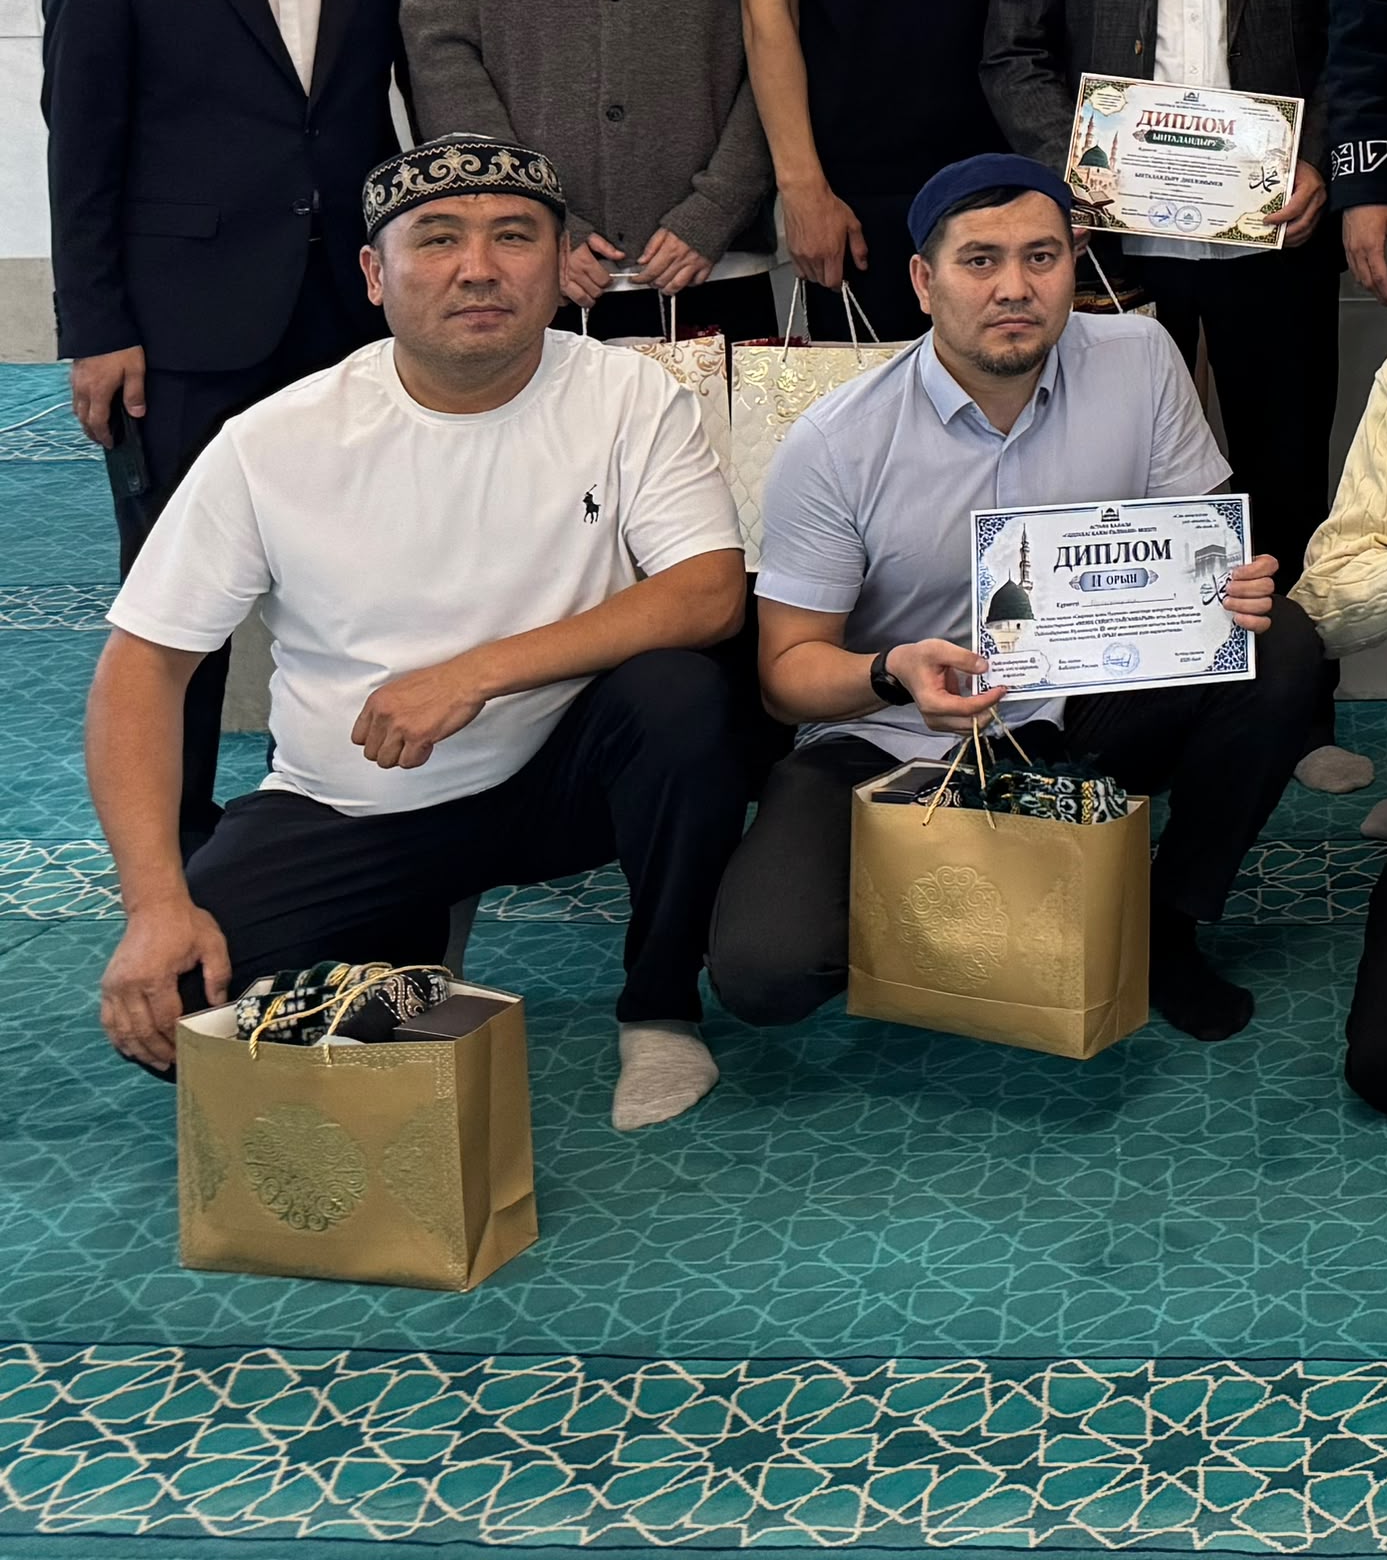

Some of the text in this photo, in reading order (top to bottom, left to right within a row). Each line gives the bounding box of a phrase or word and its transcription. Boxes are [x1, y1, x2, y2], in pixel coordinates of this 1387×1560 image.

[1136, 109, 1237, 136] ДИПЛОМ
[1053, 538, 1173, 574] ДИПЛОМ
[1091, 572, 1138, 588] II ОРЫН
